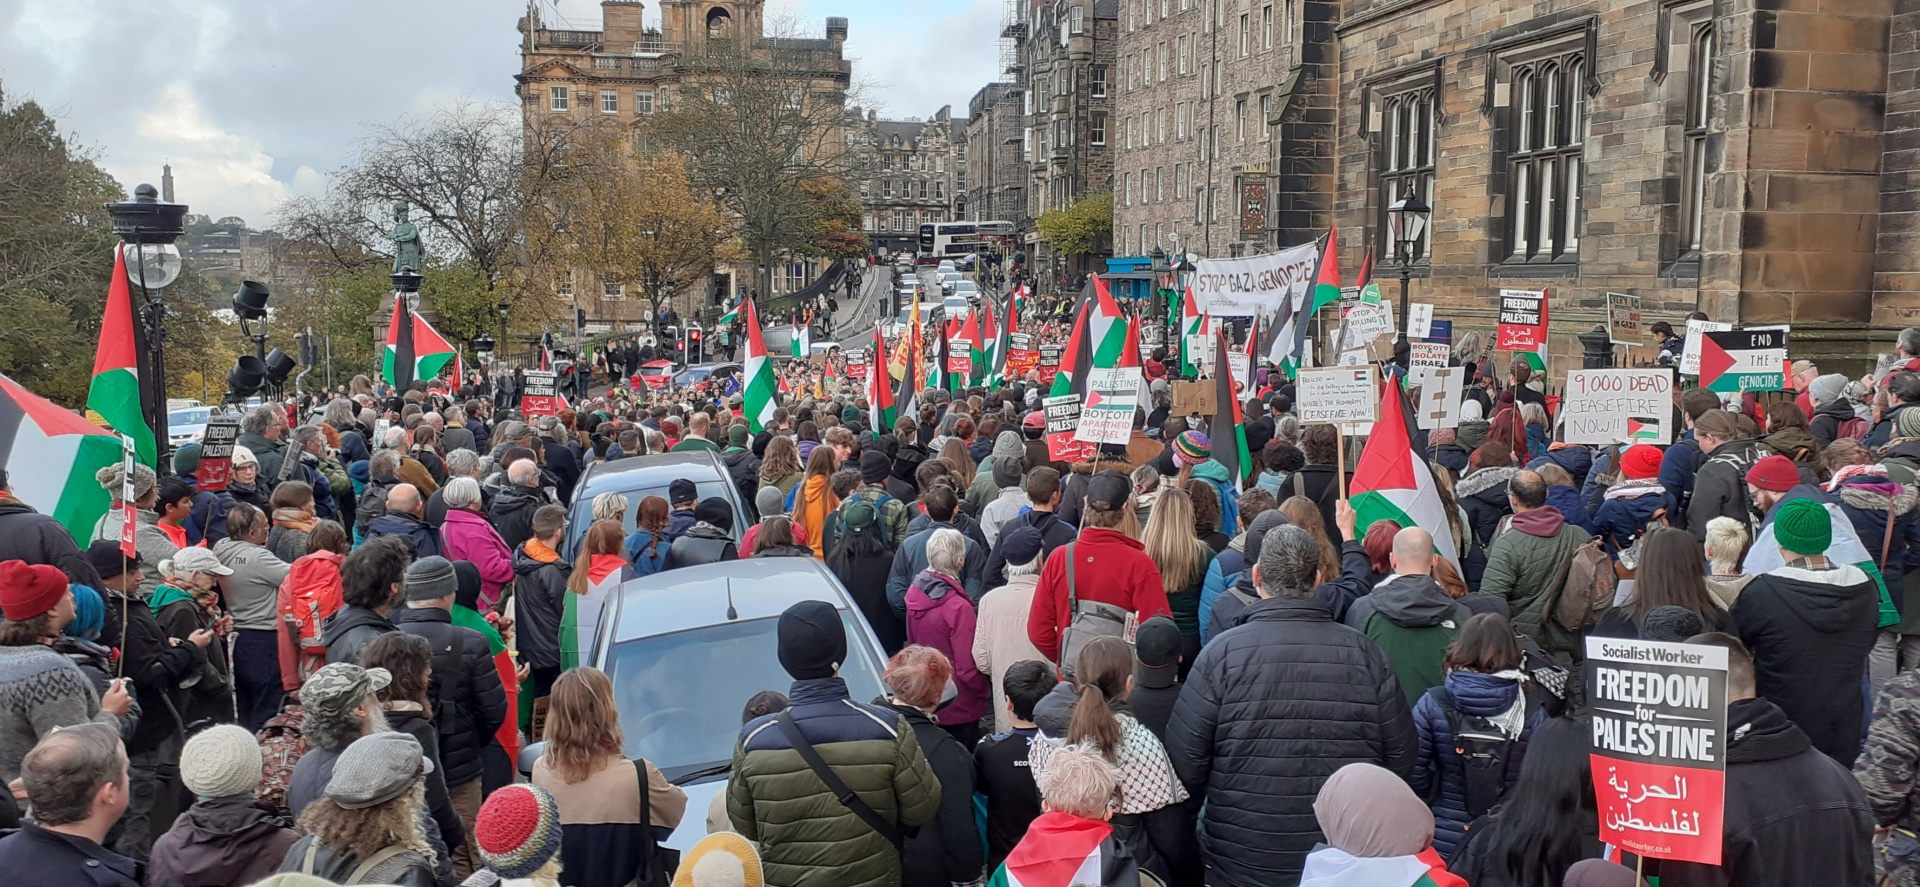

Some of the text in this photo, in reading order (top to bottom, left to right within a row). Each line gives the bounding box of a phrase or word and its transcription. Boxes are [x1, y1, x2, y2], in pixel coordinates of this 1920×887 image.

[1200, 274, 1226, 292] STOP
[1229, 273, 1258, 293] GAZA
[1504, 298, 1538, 310] FREEDOM
[1501, 313, 1539, 324] PALESTINE
[1750, 334, 1772, 347] END
[1750, 355, 1769, 366] THE
[526, 377, 554, 385] FREEDOM
[1107, 370, 1126, 380] FREE
[1738, 375, 1778, 388] GENOCIDE
[1092, 379, 1138, 388] PALESTINE
[1575, 374, 1668, 396] 9,000 DEAD
[1048, 403, 1079, 417] FREEDOM
[1568, 398, 1658, 414] CEASEFIRE
[1084, 410, 1133, 419] BOYCOTT
[1304, 409, 1347, 420] CEASEFIRE
[1082, 420, 1130, 429] APARTHEID
[208, 426, 236, 439] FREEDOM
[1087, 429, 1119, 438] ISRAEL
[202, 445, 233, 457] PALESTINE
[1602, 644, 1703, 665] Socialist Worker
[1597, 668, 1709, 710] FREEDOM
[1634, 704, 1655, 721] for
[1593, 716, 1715, 761] PALESTINE
[1608, 766, 1687, 803] الحرية
[1606, 802, 1699, 836] لفلسطين
